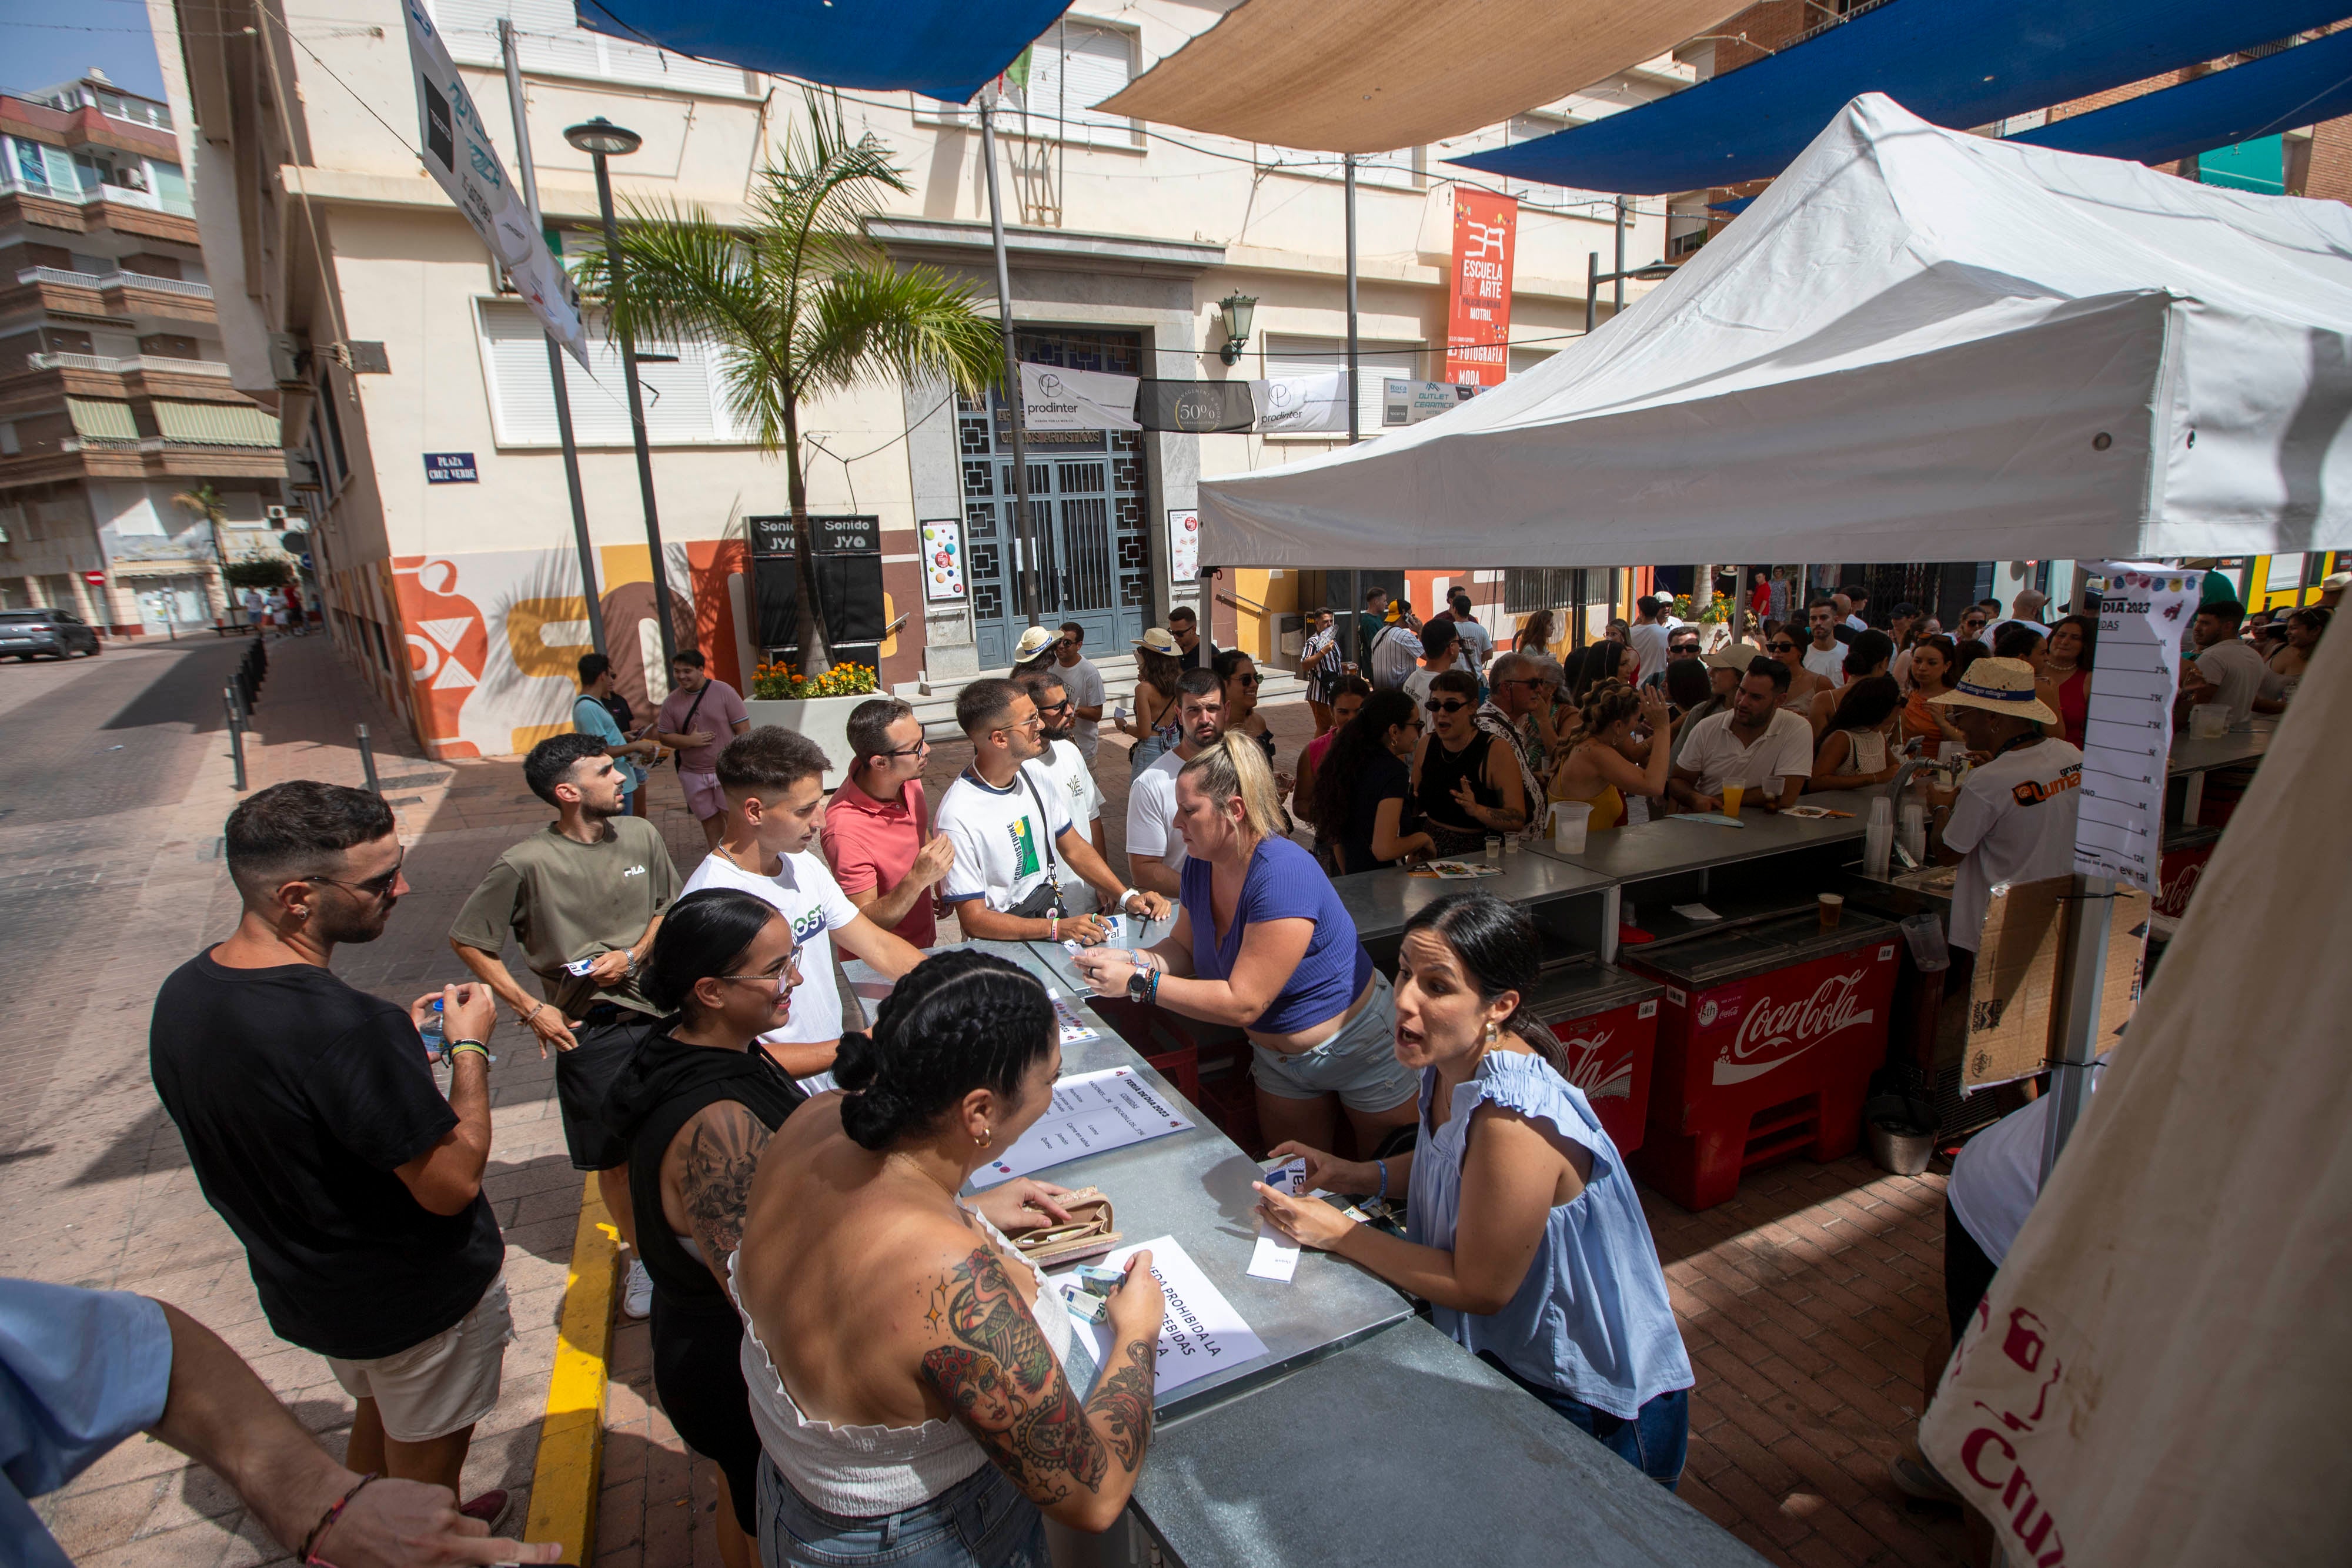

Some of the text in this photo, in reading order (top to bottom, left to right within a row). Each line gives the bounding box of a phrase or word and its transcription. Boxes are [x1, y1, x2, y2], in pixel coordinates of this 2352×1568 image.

[1464, 259, 1502, 280] ESCUELA
[1462, 278, 1502, 299] DE ARTE
[1470, 307, 1492, 321] MOTRIL
[1459, 345, 1502, 363] FOTOGRAFÍA
[1458, 369, 1479, 385] MODA
[1028, 403, 1078, 414] prodinter
[1180, 404, 1215, 419] 50%
[1261, 410, 1302, 425] prodinter
[437, 456, 463, 467] PLAZA
[428, 469, 476, 480] CRUZ VERDE
[825, 520, 870, 531] Sonido
[2102, 601, 2151, 614] DIA 2023
[1007, 822, 1023, 881] GROUNDSTROKE
[624, 864, 646, 877] FILA
[1735, 966, 1869, 1059] Coca-Cola
[1120, 1092, 1140, 1109] COMIDAS
[1124, 1079, 1140, 1094] FERIA
[1144, 1095, 1156, 1107] DIA
[1152, 1105, 1170, 1118] 2023
[1067, 1122, 1078, 1135] Carne
[1080, 1137, 1090, 1148] salsa
[1088, 1124, 1100, 1136] Lomo
[1041, 1136, 1053, 1150] Queso
[1096, 1302, 1106, 1318] 20
[1162, 1287, 1210, 1342] PROHIBIDA
[1204, 1340, 1222, 1357] LA
